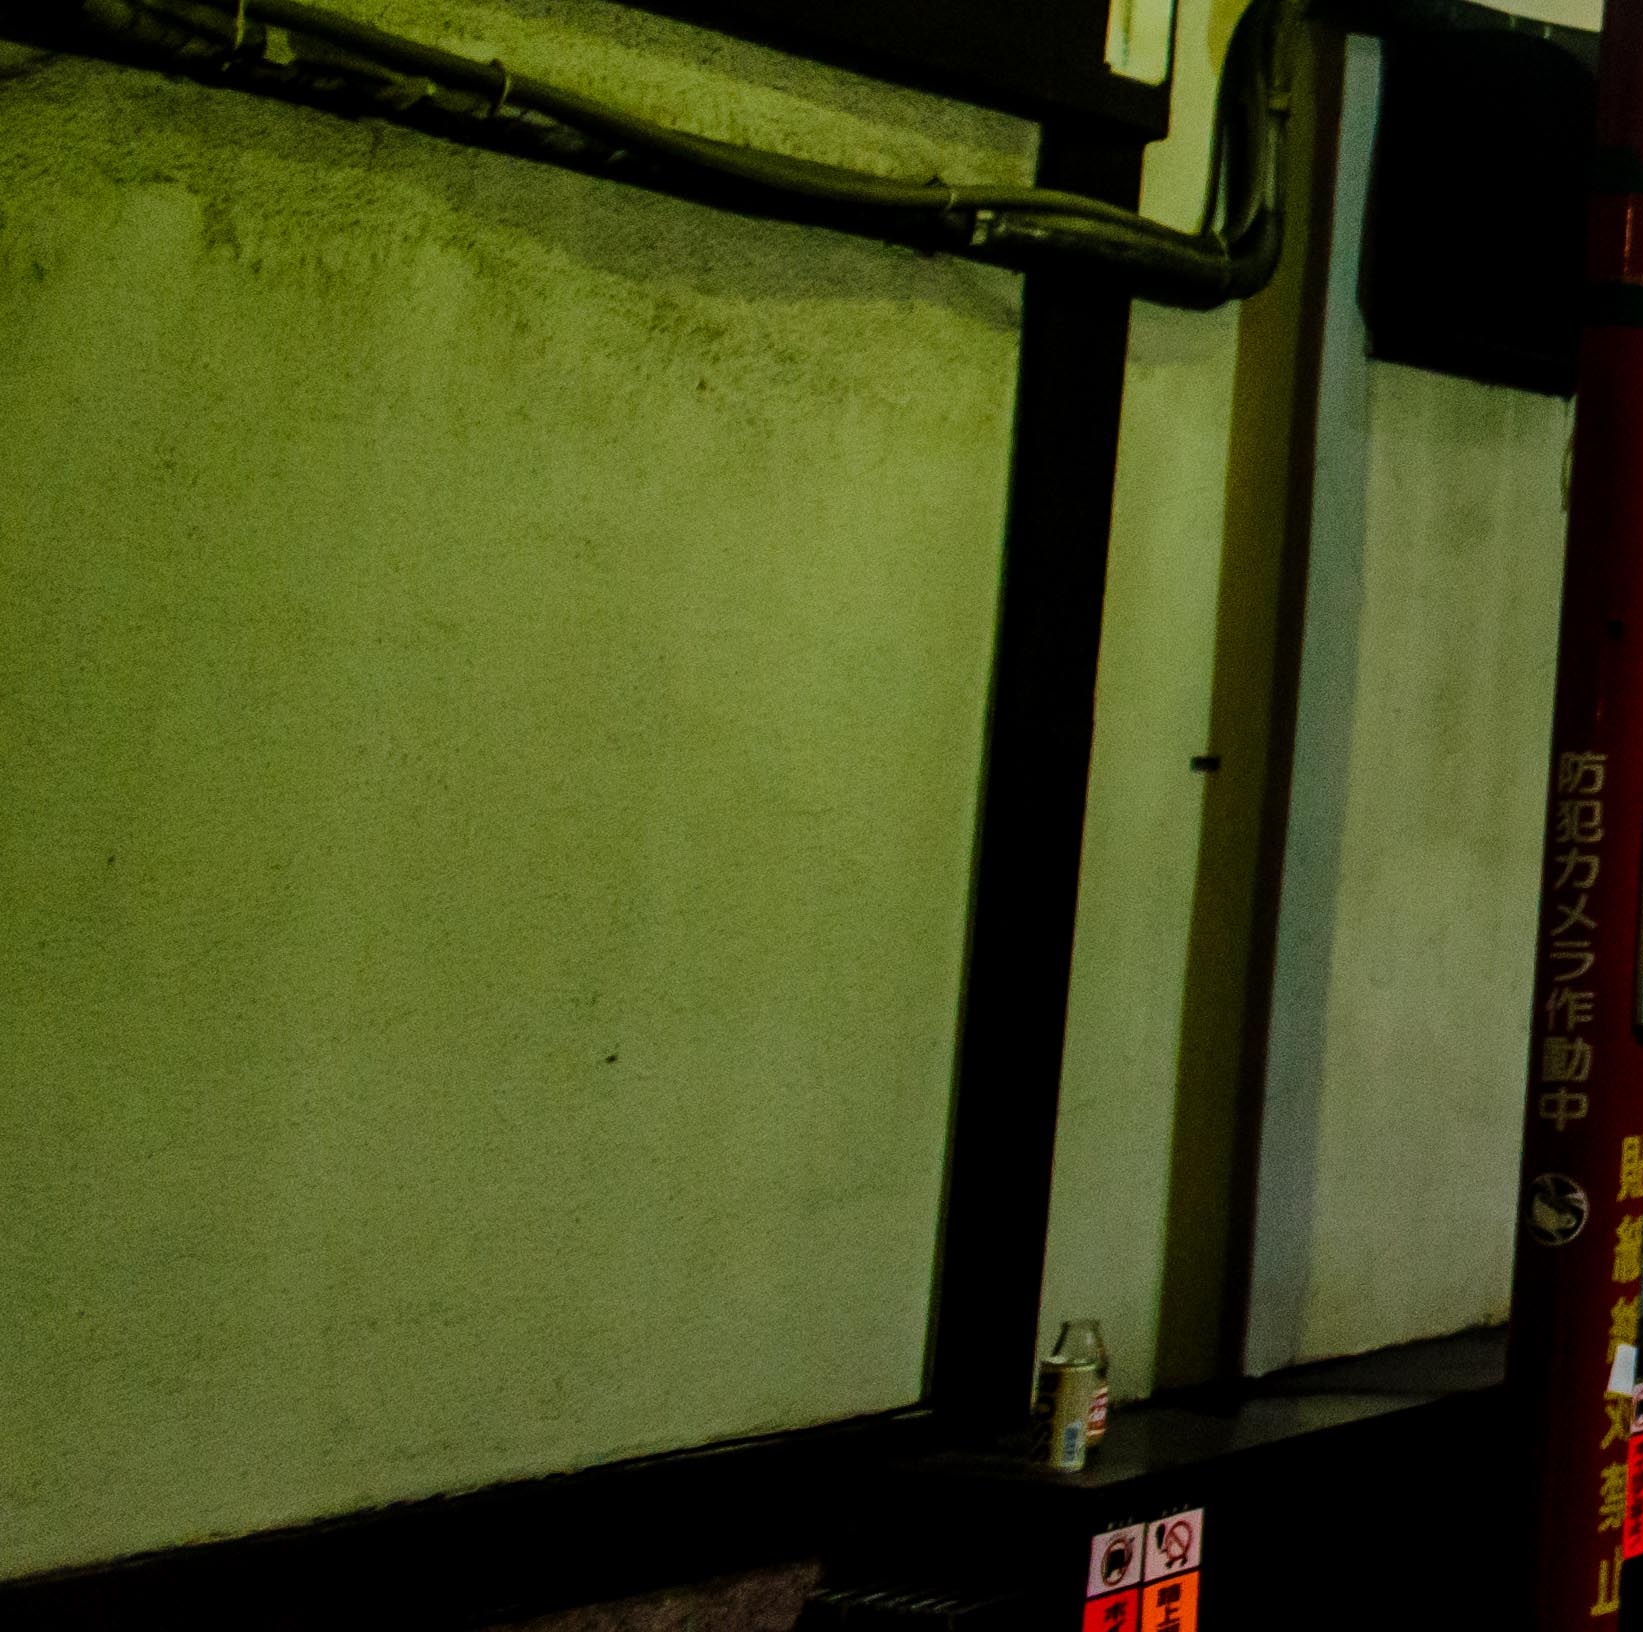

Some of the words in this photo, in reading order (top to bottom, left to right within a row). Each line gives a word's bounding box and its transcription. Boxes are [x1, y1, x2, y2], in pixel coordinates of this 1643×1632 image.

[1536, 750, 1608, 1135] 防犯カメラ作動中
